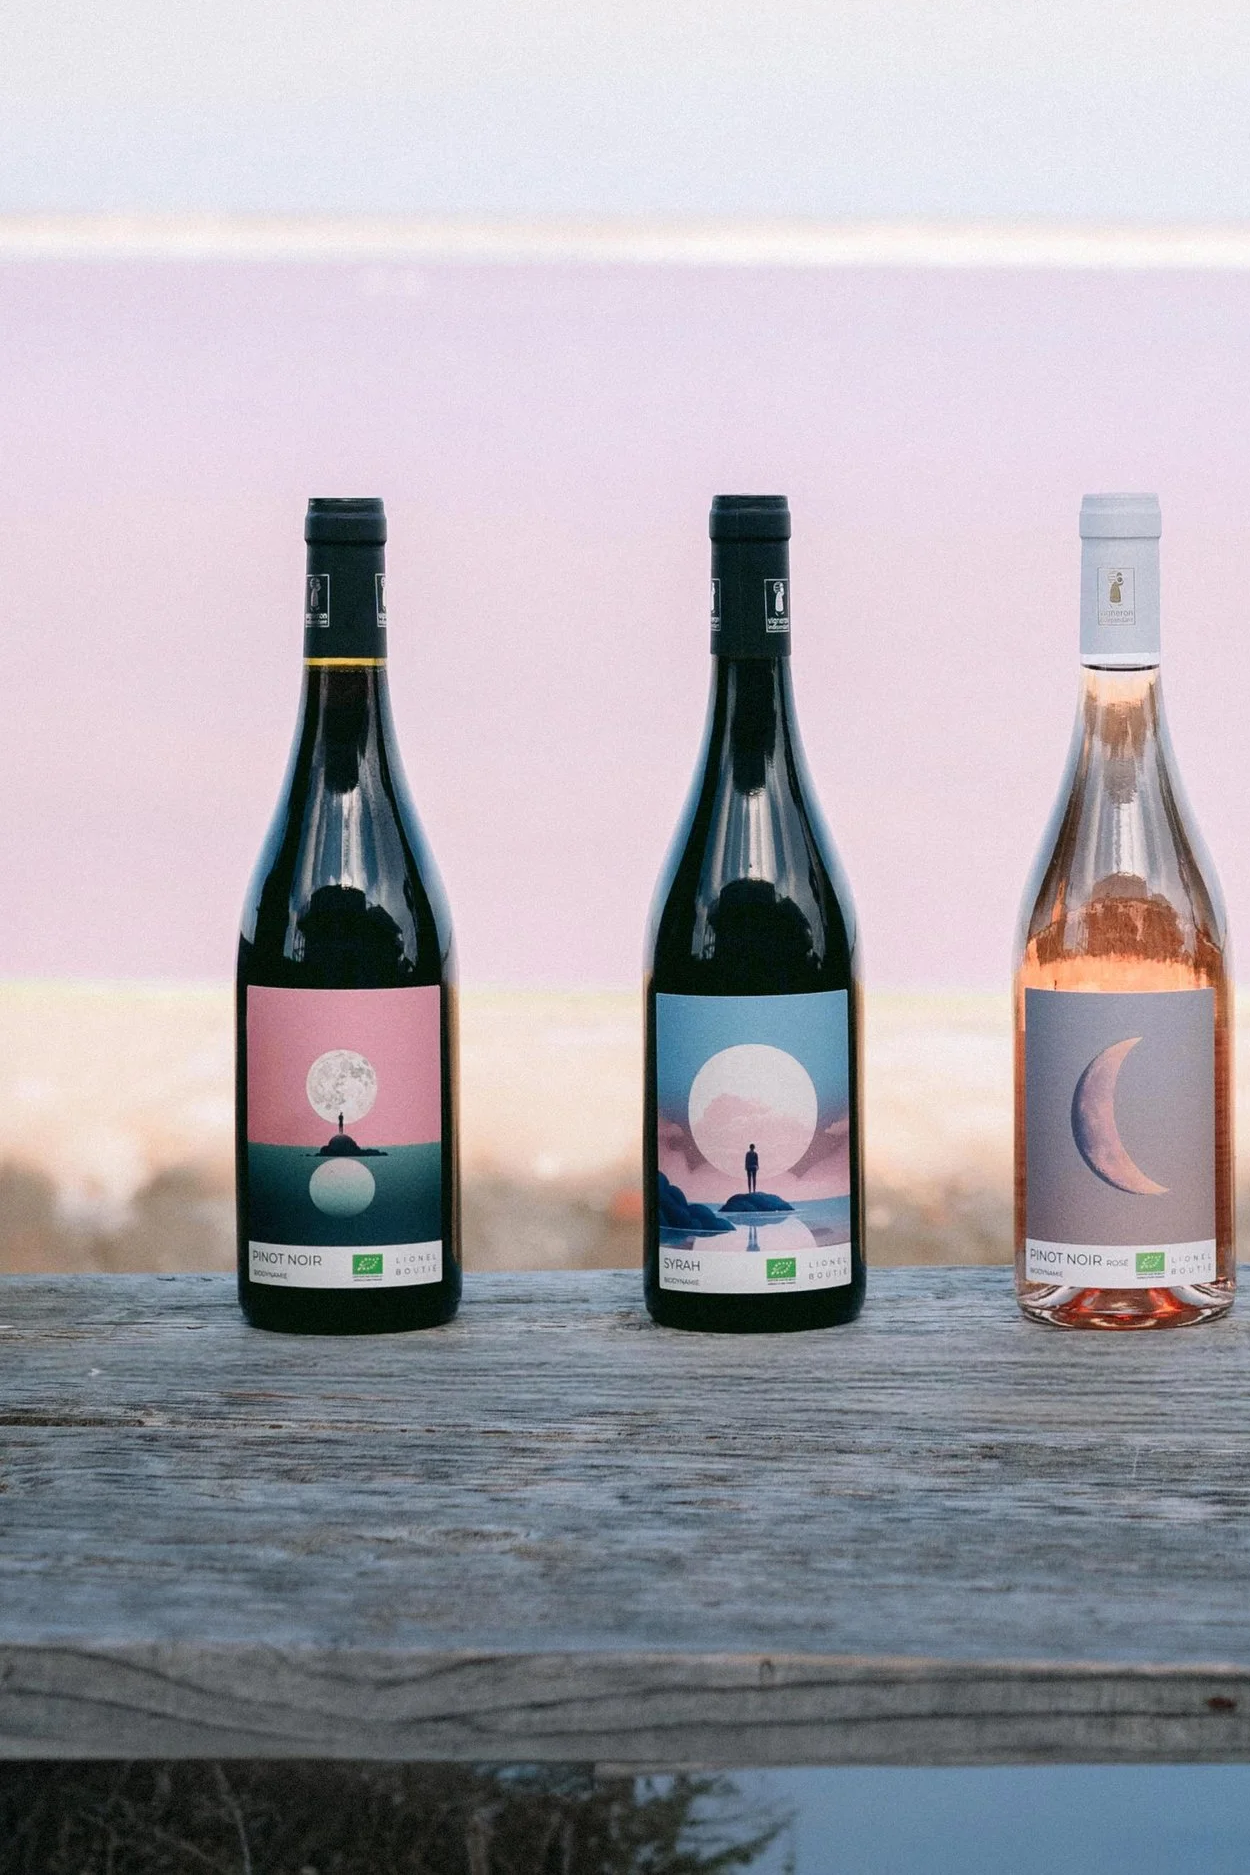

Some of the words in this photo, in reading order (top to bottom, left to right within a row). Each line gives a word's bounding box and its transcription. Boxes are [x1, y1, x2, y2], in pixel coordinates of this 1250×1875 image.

[252, 1250, 285, 1265] PINOT
[287, 1253, 322, 1266] NOIR
[395, 1253, 437, 1264] LIONEL
[808, 1258, 848, 1269] LIONEL
[1030, 1248, 1063, 1263] PINOT
[1067, 1253, 1102, 1266] NOIR
[1170, 1253, 1212, 1264] LIONEL
[663, 1257, 700, 1272] SYRAH
